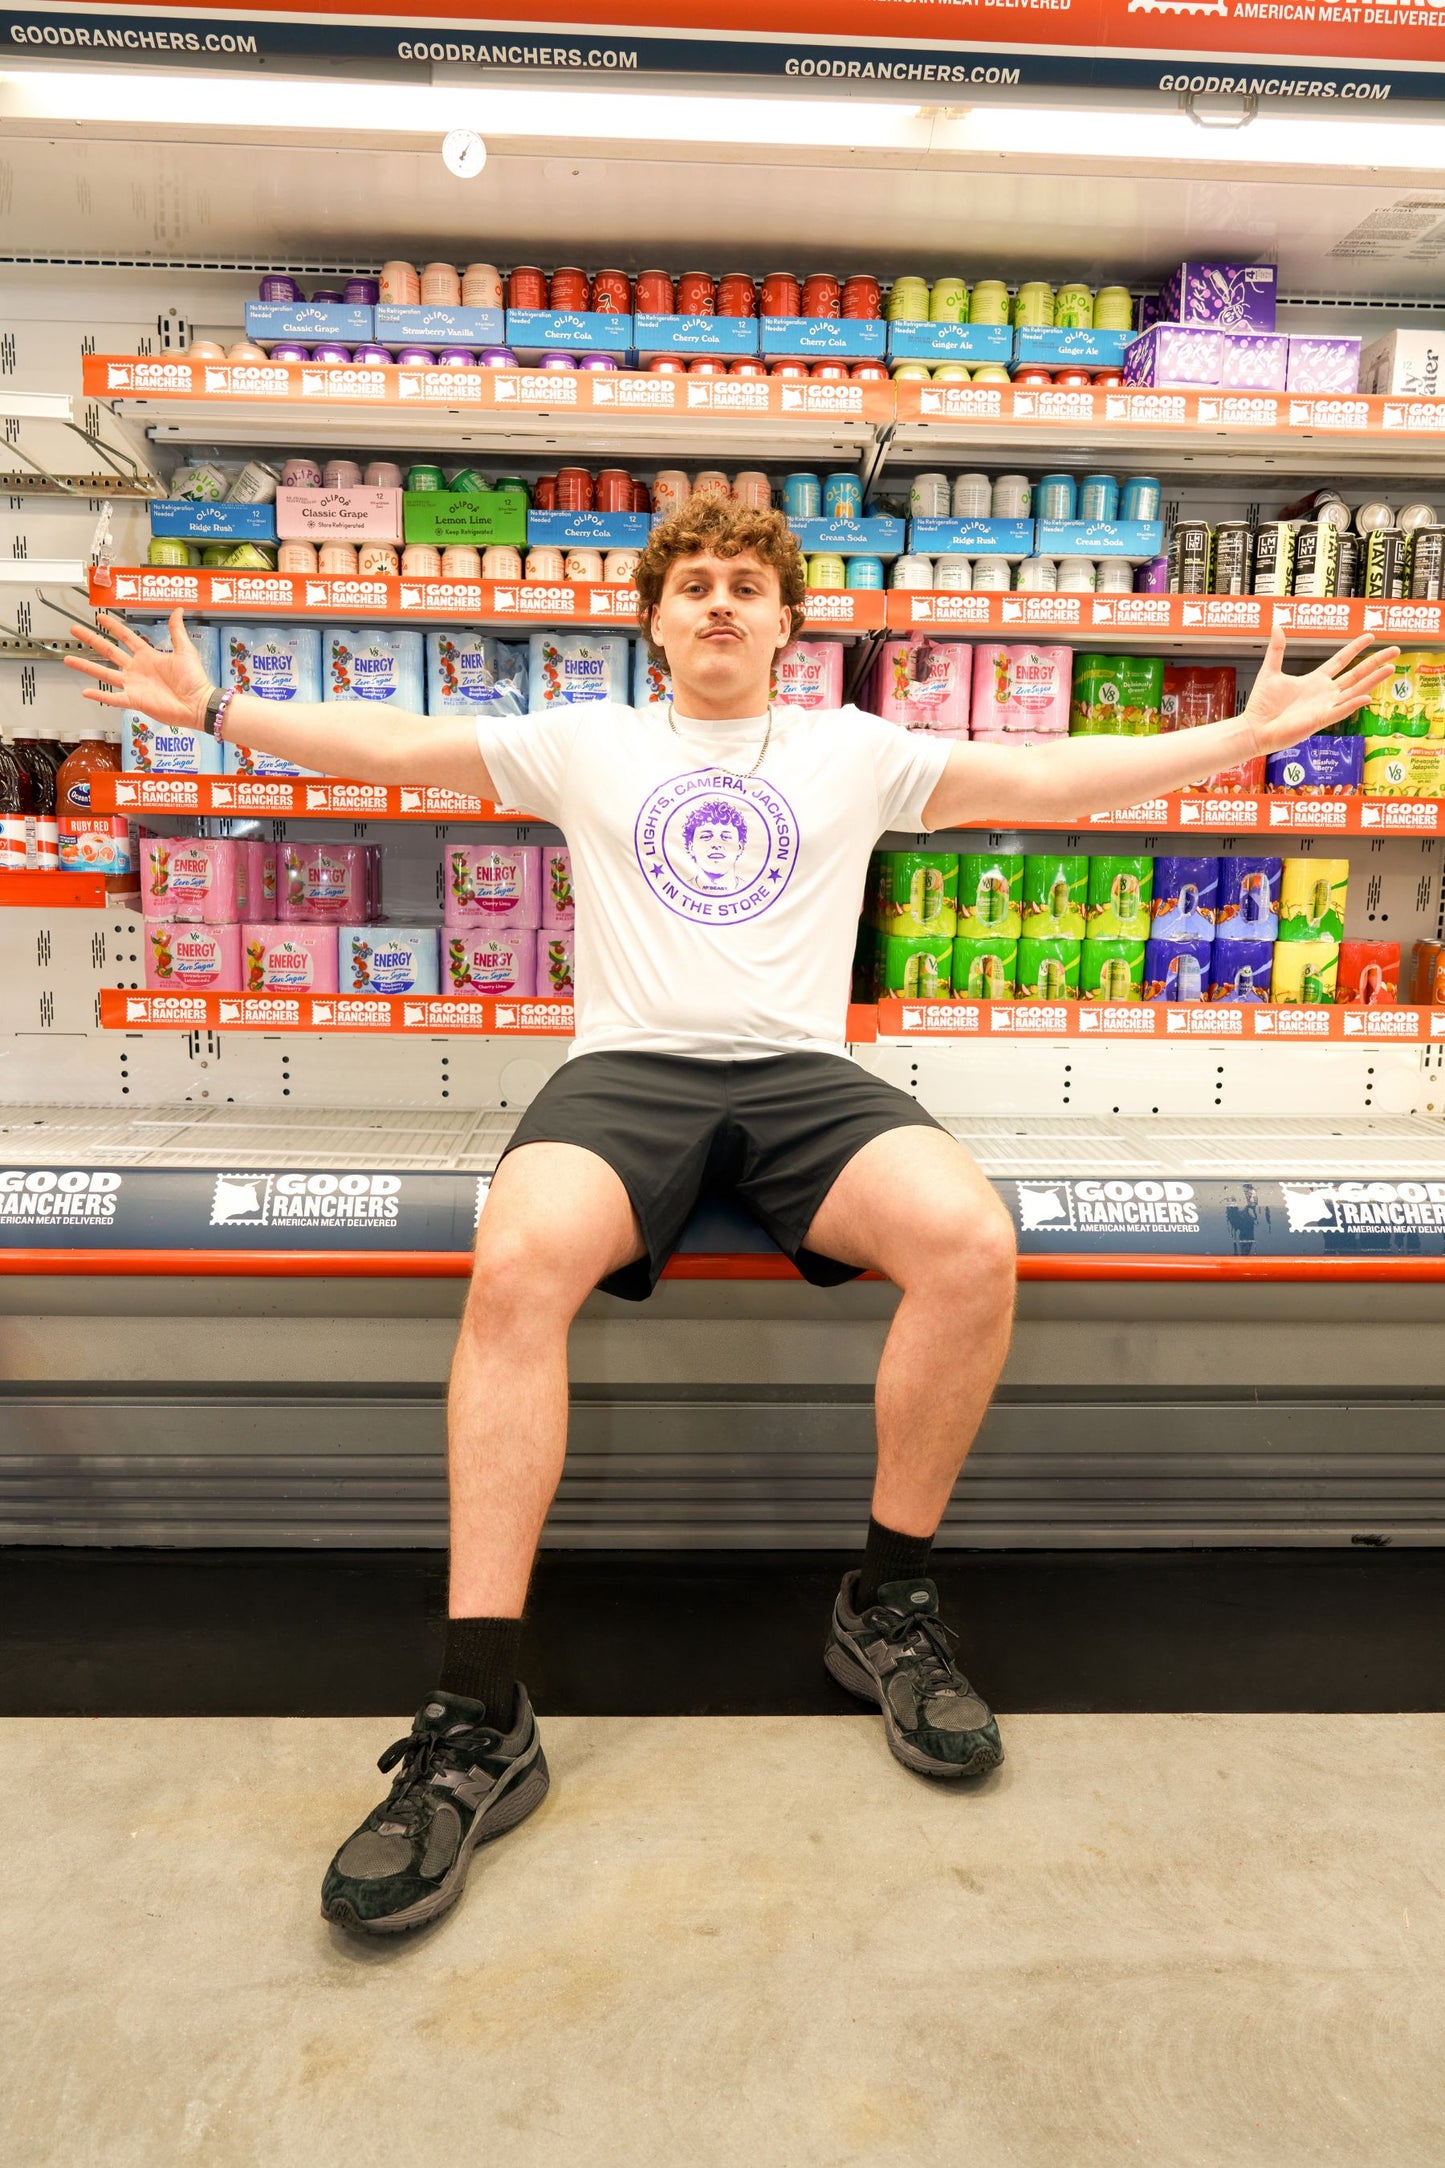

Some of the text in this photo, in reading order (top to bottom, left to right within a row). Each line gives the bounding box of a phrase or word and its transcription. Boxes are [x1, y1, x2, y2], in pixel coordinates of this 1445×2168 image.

[1234, 4, 1445, 26] AMERICAN MEAT DELIVERED
[10, 25, 258, 54] GOODRANCHERS.COM
[397, 42, 639, 68] GOODRANCHERS.COM
[784, 58, 1020, 85] GOODRANCHERS.COM
[1158, 74, 1392, 100] GOODRANCHERS.COM
[283, 324, 340, 334] Classic Grape
[402, 326, 474, 337] Strawberry Vanilla
[544, 330, 592, 340] Cherry Cola
[672, 334, 720, 344] Cherry Cola
[800, 338, 846, 347] Cherry Cola
[932, 340, 973, 350] Ginger Ale
[1058, 346, 1084, 355] Ginger
[134, 364, 192, 377] GOOD
[134, 376, 192, 388] RANCHERS
[520, 376, 578, 389] GOOD
[520, 388, 578, 400] RANCHERS
[946, 389, 1002, 402] GOOD
[946, 401, 1002, 413] RANCHERS
[1224, 398, 1278, 411] GOOD
[1224, 410, 1278, 422] RANCHERS
[302, 508, 368, 520] Classic Grape
[435, 516, 492, 524] Lemon Lime
[190, 524, 212, 533] Ridge
[564, 528, 611, 538] Cherry Cola
[820, 534, 868, 542] Cream Soda
[952, 536, 996, 546] Ridge Rush
[1076, 538, 1124, 546] Cream Soda
[1371, 530, 1384, 569] STAY
[142, 576, 198, 588] GOOD
[332, 582, 388, 594] GOOD
[142, 587, 198, 598] RANCHERS
[332, 593, 388, 604] RANCHERS
[520, 588, 574, 599] GOOD
[520, 598, 574, 610] RANCHERS
[936, 597, 990, 608] GOOD
[1208, 602, 1262, 613] GOOD
[936, 607, 990, 619] RANCHERS
[1208, 612, 1262, 624] RANCHERS
[1388, 606, 1442, 618] GOOD
[1388, 617, 1442, 629] RANCHERS
[252, 655, 292, 670] ENERGY
[354, 658, 394, 673] ENERGY
[564, 659, 604, 674] ENERGY
[782, 664, 822, 680] ENERGY
[1016, 665, 1054, 680] ENERGY
[1102, 685, 1116, 702] V8
[1395, 682, 1408, 698] V8
[155, 737, 195, 752] ENERGY
[1410, 758, 1440, 768] Pineapple
[1288, 766, 1301, 782] V8
[1388, 765, 1402, 782] V8
[142, 781, 198, 793] GOOD
[238, 783, 294, 795] GOOD
[332, 786, 388, 797] GOOD
[142, 792, 198, 804] RANCHERS
[238, 794, 294, 806] RANCHERS
[332, 796, 388, 808] RANCHERS
[1204, 800, 1258, 812] GOOD
[1294, 802, 1346, 813] GOOD
[1386, 803, 1438, 815] GOOD
[644, 776, 790, 860] LIGHTS, CAMERA, JACKSON
[1204, 811, 1258, 822] RANCHERS
[1294, 812, 1346, 824] RANCHERS
[1386, 814, 1438, 825] RANCHERS
[71, 821, 109, 832] RUBY RED
[174, 859, 208, 873] ENERGY
[476, 866, 516, 881] ENERGY
[662, 881, 770, 916] IN THE STORE
[176, 942, 216, 956] ENERGY
[269, 954, 308, 969] ENERGY
[374, 952, 412, 968] ENERGY
[474, 952, 513, 967] ENERGY
[152, 998, 206, 1009] GOOD
[338, 1001, 392, 1012] GOOD
[428, 1003, 484, 1014] GOOD
[152, 1008, 206, 1020] RANCHERS
[338, 1011, 392, 1023] RANCHERS
[428, 1013, 484, 1024] RANCHERS
[1016, 1007, 1068, 1018] GOOD
[1190, 1009, 1242, 1020] GOOD
[1368, 1011, 1420, 1023] GOOD
[1016, 1017, 1068, 1028] RANCHERS
[1190, 1019, 1242, 1031] RANCHERS
[1368, 1022, 1420, 1033] RANCHERS
[0, 1170, 122, 1193] GOOD
[276, 1174, 402, 1196] GOOD
[1074, 1180, 1194, 1202] GOOD
[272, 1195, 399, 1218] RANCHERS
[1076, 1202, 1199, 1224] RANCHERS
[62, 1217, 114, 1225] DELIVERED
[271, 1218, 398, 1227] AMERICAN MEAT DELIVERED
[1080, 1224, 1200, 1232] AMERICAN MEAT DELIVERED
